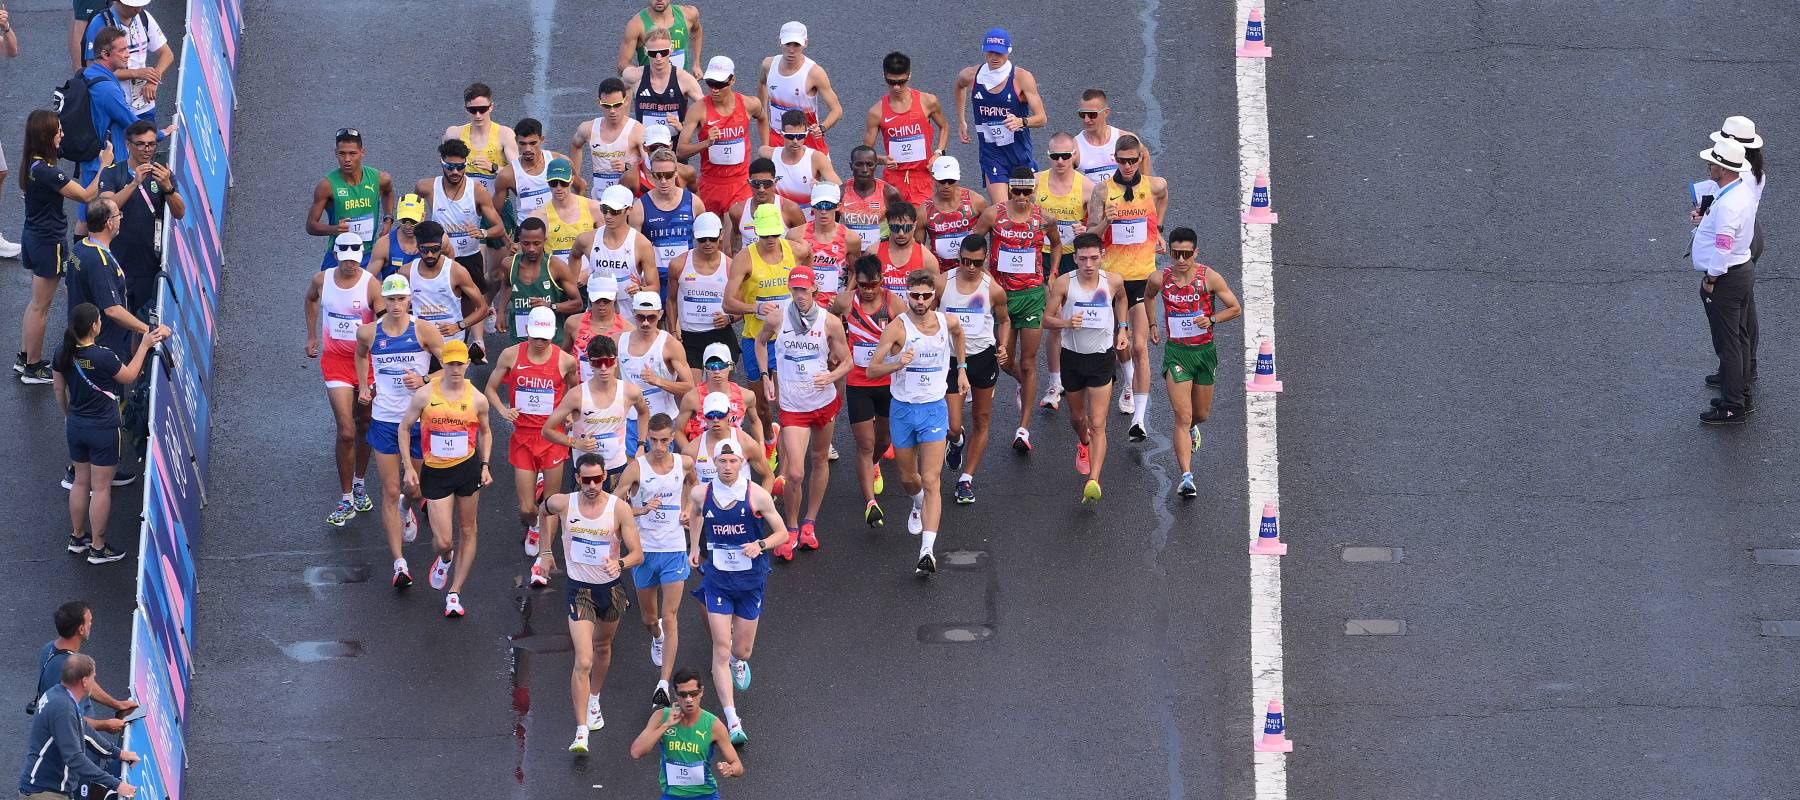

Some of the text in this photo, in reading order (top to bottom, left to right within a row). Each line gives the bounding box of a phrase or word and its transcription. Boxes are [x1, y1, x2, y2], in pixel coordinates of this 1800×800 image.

[986, 37, 1005, 45] FRANCE
[718, 126, 744, 138] HINA
[888, 123, 922, 138] CHINA
[991, 127, 1002, 136] 38
[723, 147, 732, 155] 21
[901, 143, 912, 152] 22
[345, 197, 372, 210] BRASIL
[536, 198, 543, 206] 51
[1116, 209, 1146, 217] ERMANY
[844, 212, 879, 224] KENYA
[354, 224, 361, 232] 17
[935, 219, 969, 232] MÉXICO
[1125, 225, 1134, 234] 42
[1000, 229, 1034, 239] MÉXICO
[456, 239, 467, 247] 48
[949, 240, 960, 248] 64
[664, 249, 675, 257] 36
[1011, 255, 1023, 263] 63
[596, 259, 629, 270] KOREA
[758, 277, 787, 288] SWEDE
[1168, 293, 1201, 303] MÉXICO
[696, 304, 707, 313] 28
[1085, 309, 1096, 318] 44
[959, 314, 970, 323] 43
[338, 321, 350, 329] 69
[783, 340, 819, 351] CANADA
[377, 355, 415, 363] SLOVAKIA
[796, 364, 805, 372] 18
[517, 375, 554, 389] CHINA
[920, 374, 930, 382] 54
[529, 396, 540, 404] 23
[431, 417, 464, 426] GERMAN
[444, 439, 453, 447] 41
[655, 511, 666, 519] 53
[712, 523, 747, 535] FRANCE
[579, 546, 591, 555] 33
[668, 741, 700, 754] BRASIL
[679, 768, 689, 776] 15
